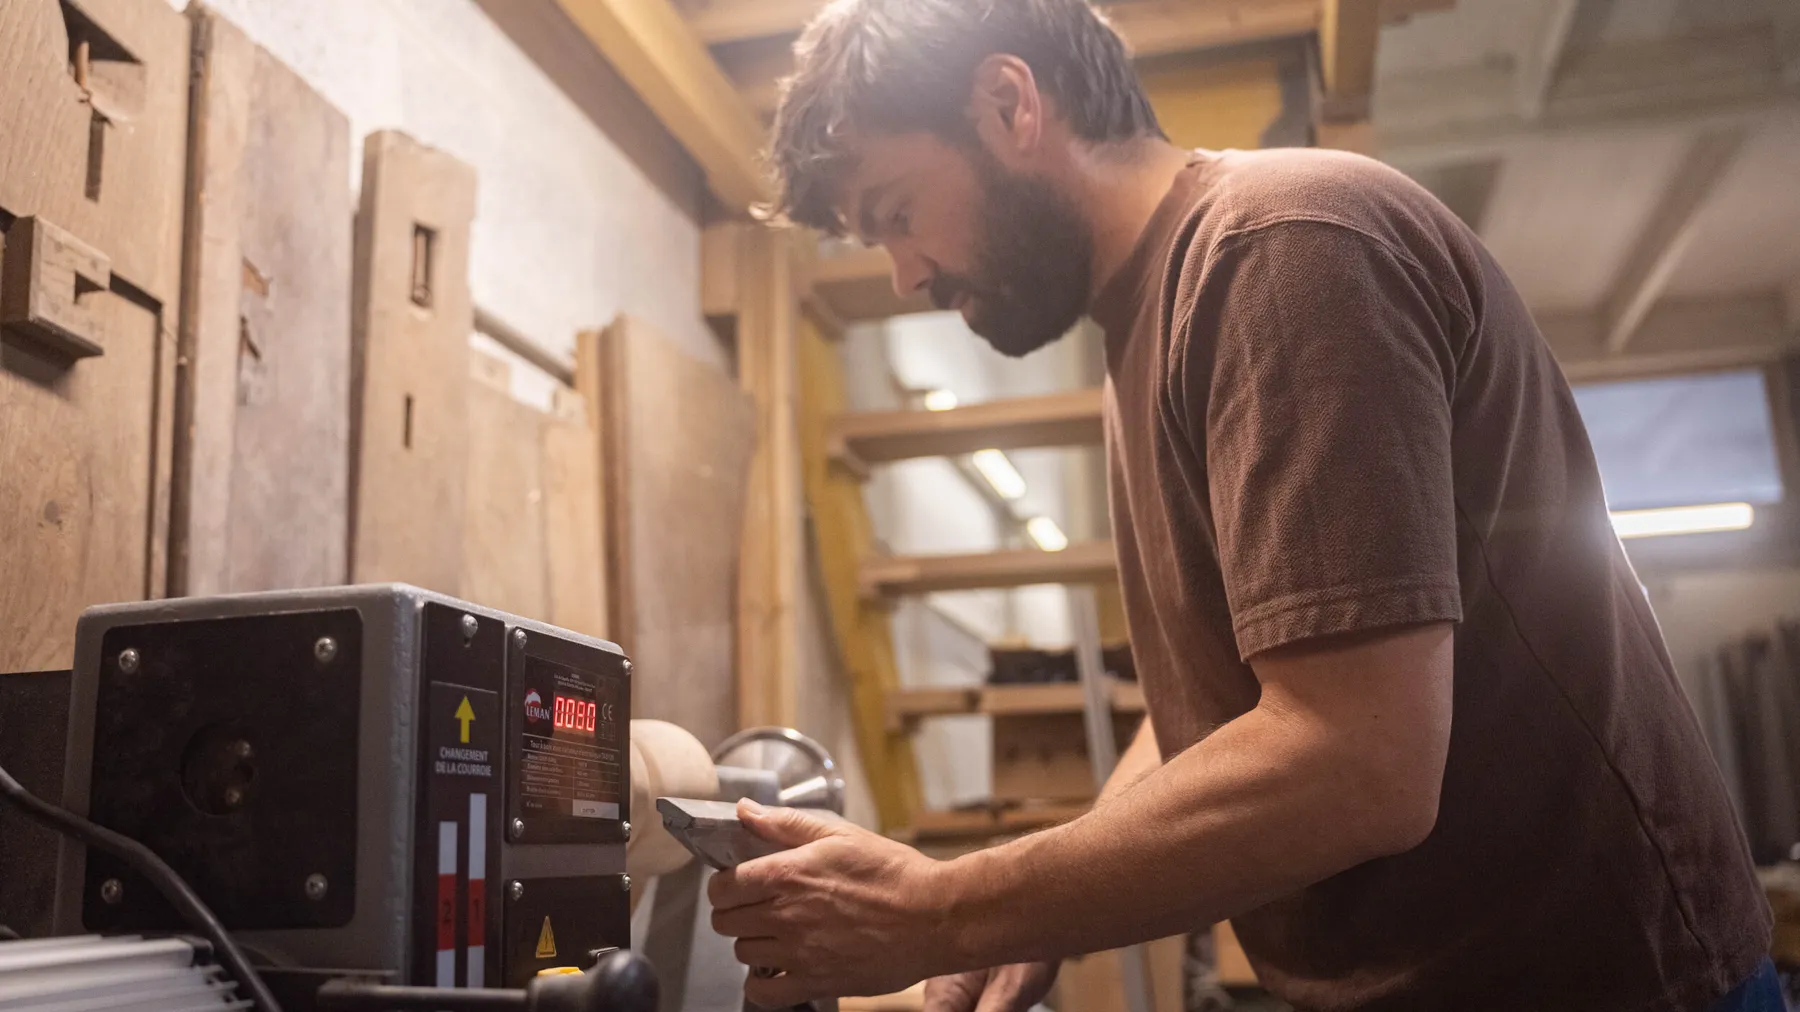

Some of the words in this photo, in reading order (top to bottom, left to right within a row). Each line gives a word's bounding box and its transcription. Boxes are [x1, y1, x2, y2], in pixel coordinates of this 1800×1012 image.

[526, 705, 550, 720] LEMAN
[554, 696, 596, 732] 0080
[602, 703, 613, 721] CE
[439, 746, 488, 761] CHANGEMENT
[435, 761, 446, 774] DE
[446, 762, 456, 774] LA
[457, 763, 492, 776] COURROIE
[443, 900, 452, 924] 2
[473, 898, 480, 921] 1
